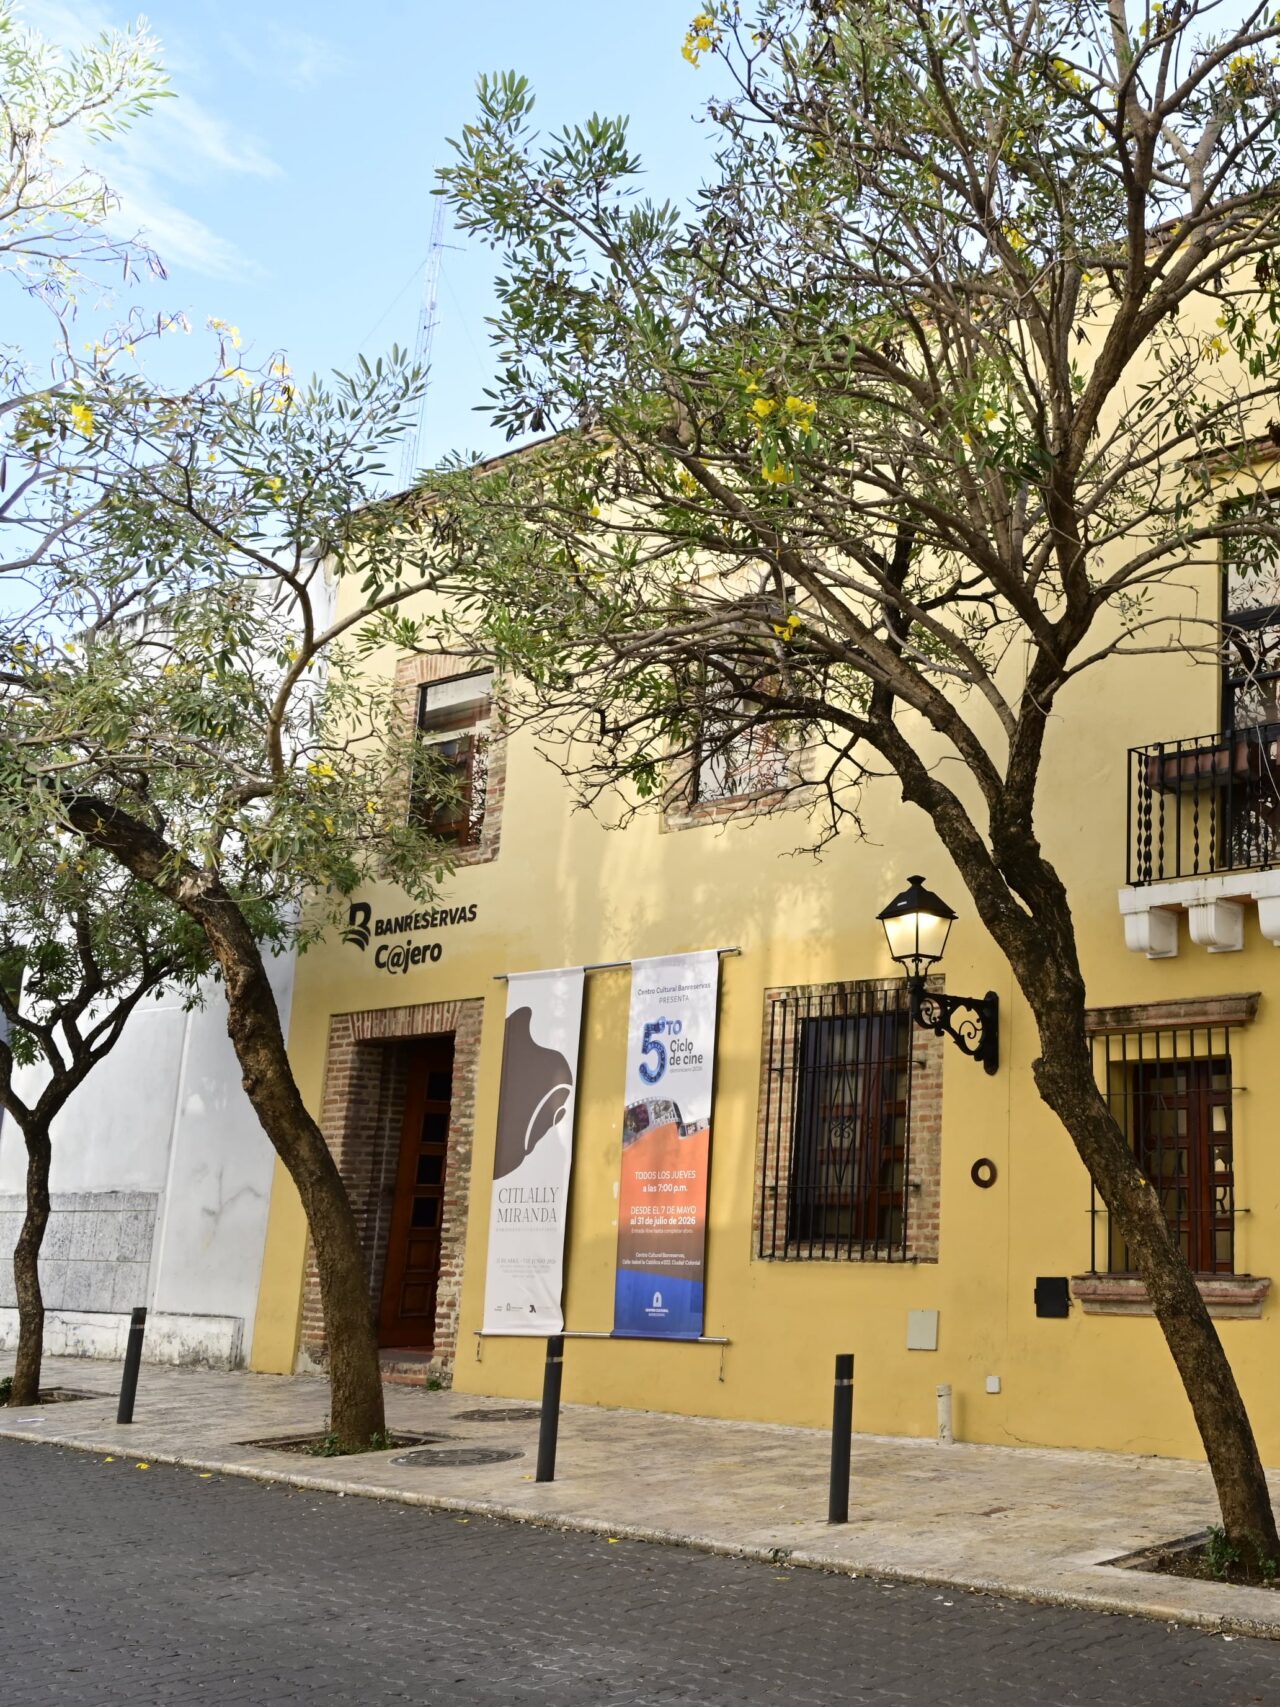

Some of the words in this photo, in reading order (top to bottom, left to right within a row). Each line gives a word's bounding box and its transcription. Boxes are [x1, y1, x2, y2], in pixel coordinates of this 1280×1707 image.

[375, 904, 478, 936] BANRESERVAS
[375, 940, 443, 974] C@jero
[638, 988, 655, 996] Centro
[656, 986, 676, 994] Cultural
[659, 995, 690, 1004] PRESENTA
[670, 1038, 694, 1053] Ciclo
[669, 1054, 681, 1066] de
[683, 1053, 703, 1065] cine
[635, 1171, 656, 1180] TODOS
[657, 1171, 670, 1179] LOS
[671, 1170, 696, 1179] JUEVES
[658, 1184, 673, 1192] 7:00
[498, 1187, 559, 1204] CITLALLY
[497, 1207, 557, 1223] MIRANDA
[631, 1206, 651, 1214] DESDE
[653, 1206, 660, 1214] EL
[667, 1206, 675, 1214] DE
[676, 1205, 696, 1214] MAYO
[630, 1217, 636, 1225] al
[645, 1217, 653, 1225] de
[653, 1217, 667, 1227] julio
[668, 1217, 677, 1225] de
